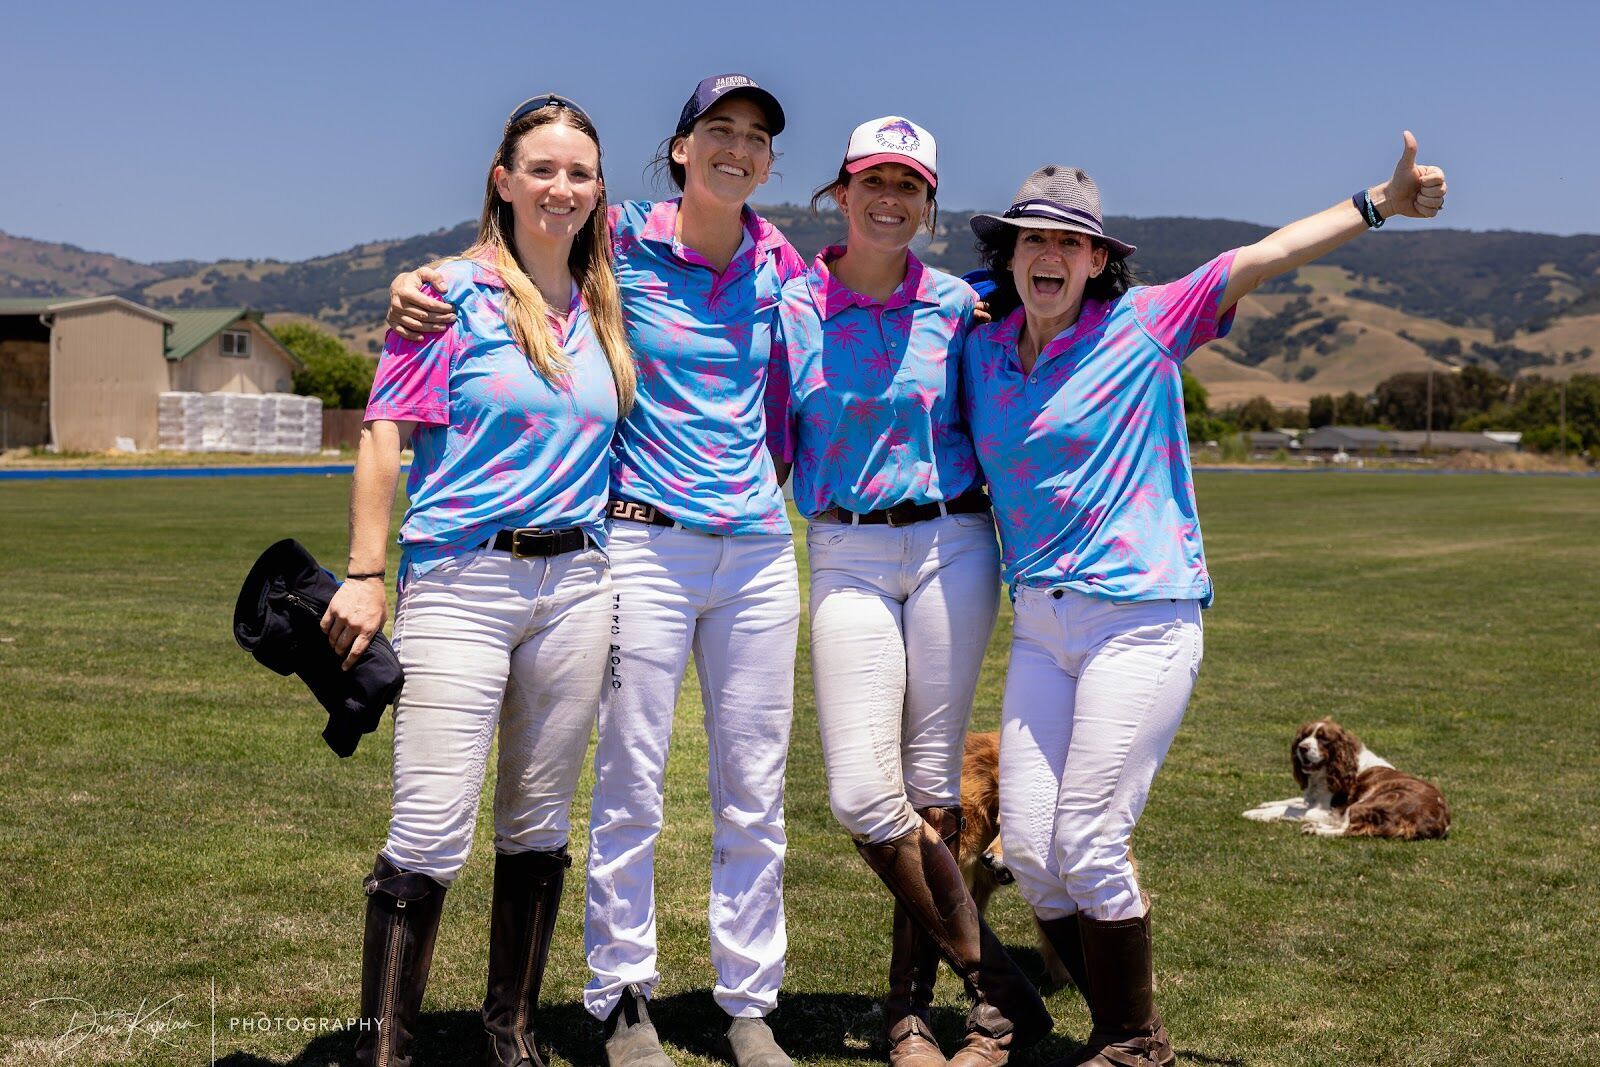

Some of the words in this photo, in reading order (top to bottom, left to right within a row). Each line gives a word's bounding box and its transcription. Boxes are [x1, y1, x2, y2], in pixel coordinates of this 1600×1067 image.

[715, 75, 748, 86] JACKSON
[875, 133, 921, 152] BEERWOOD
[609, 644, 622, 689] POLO
